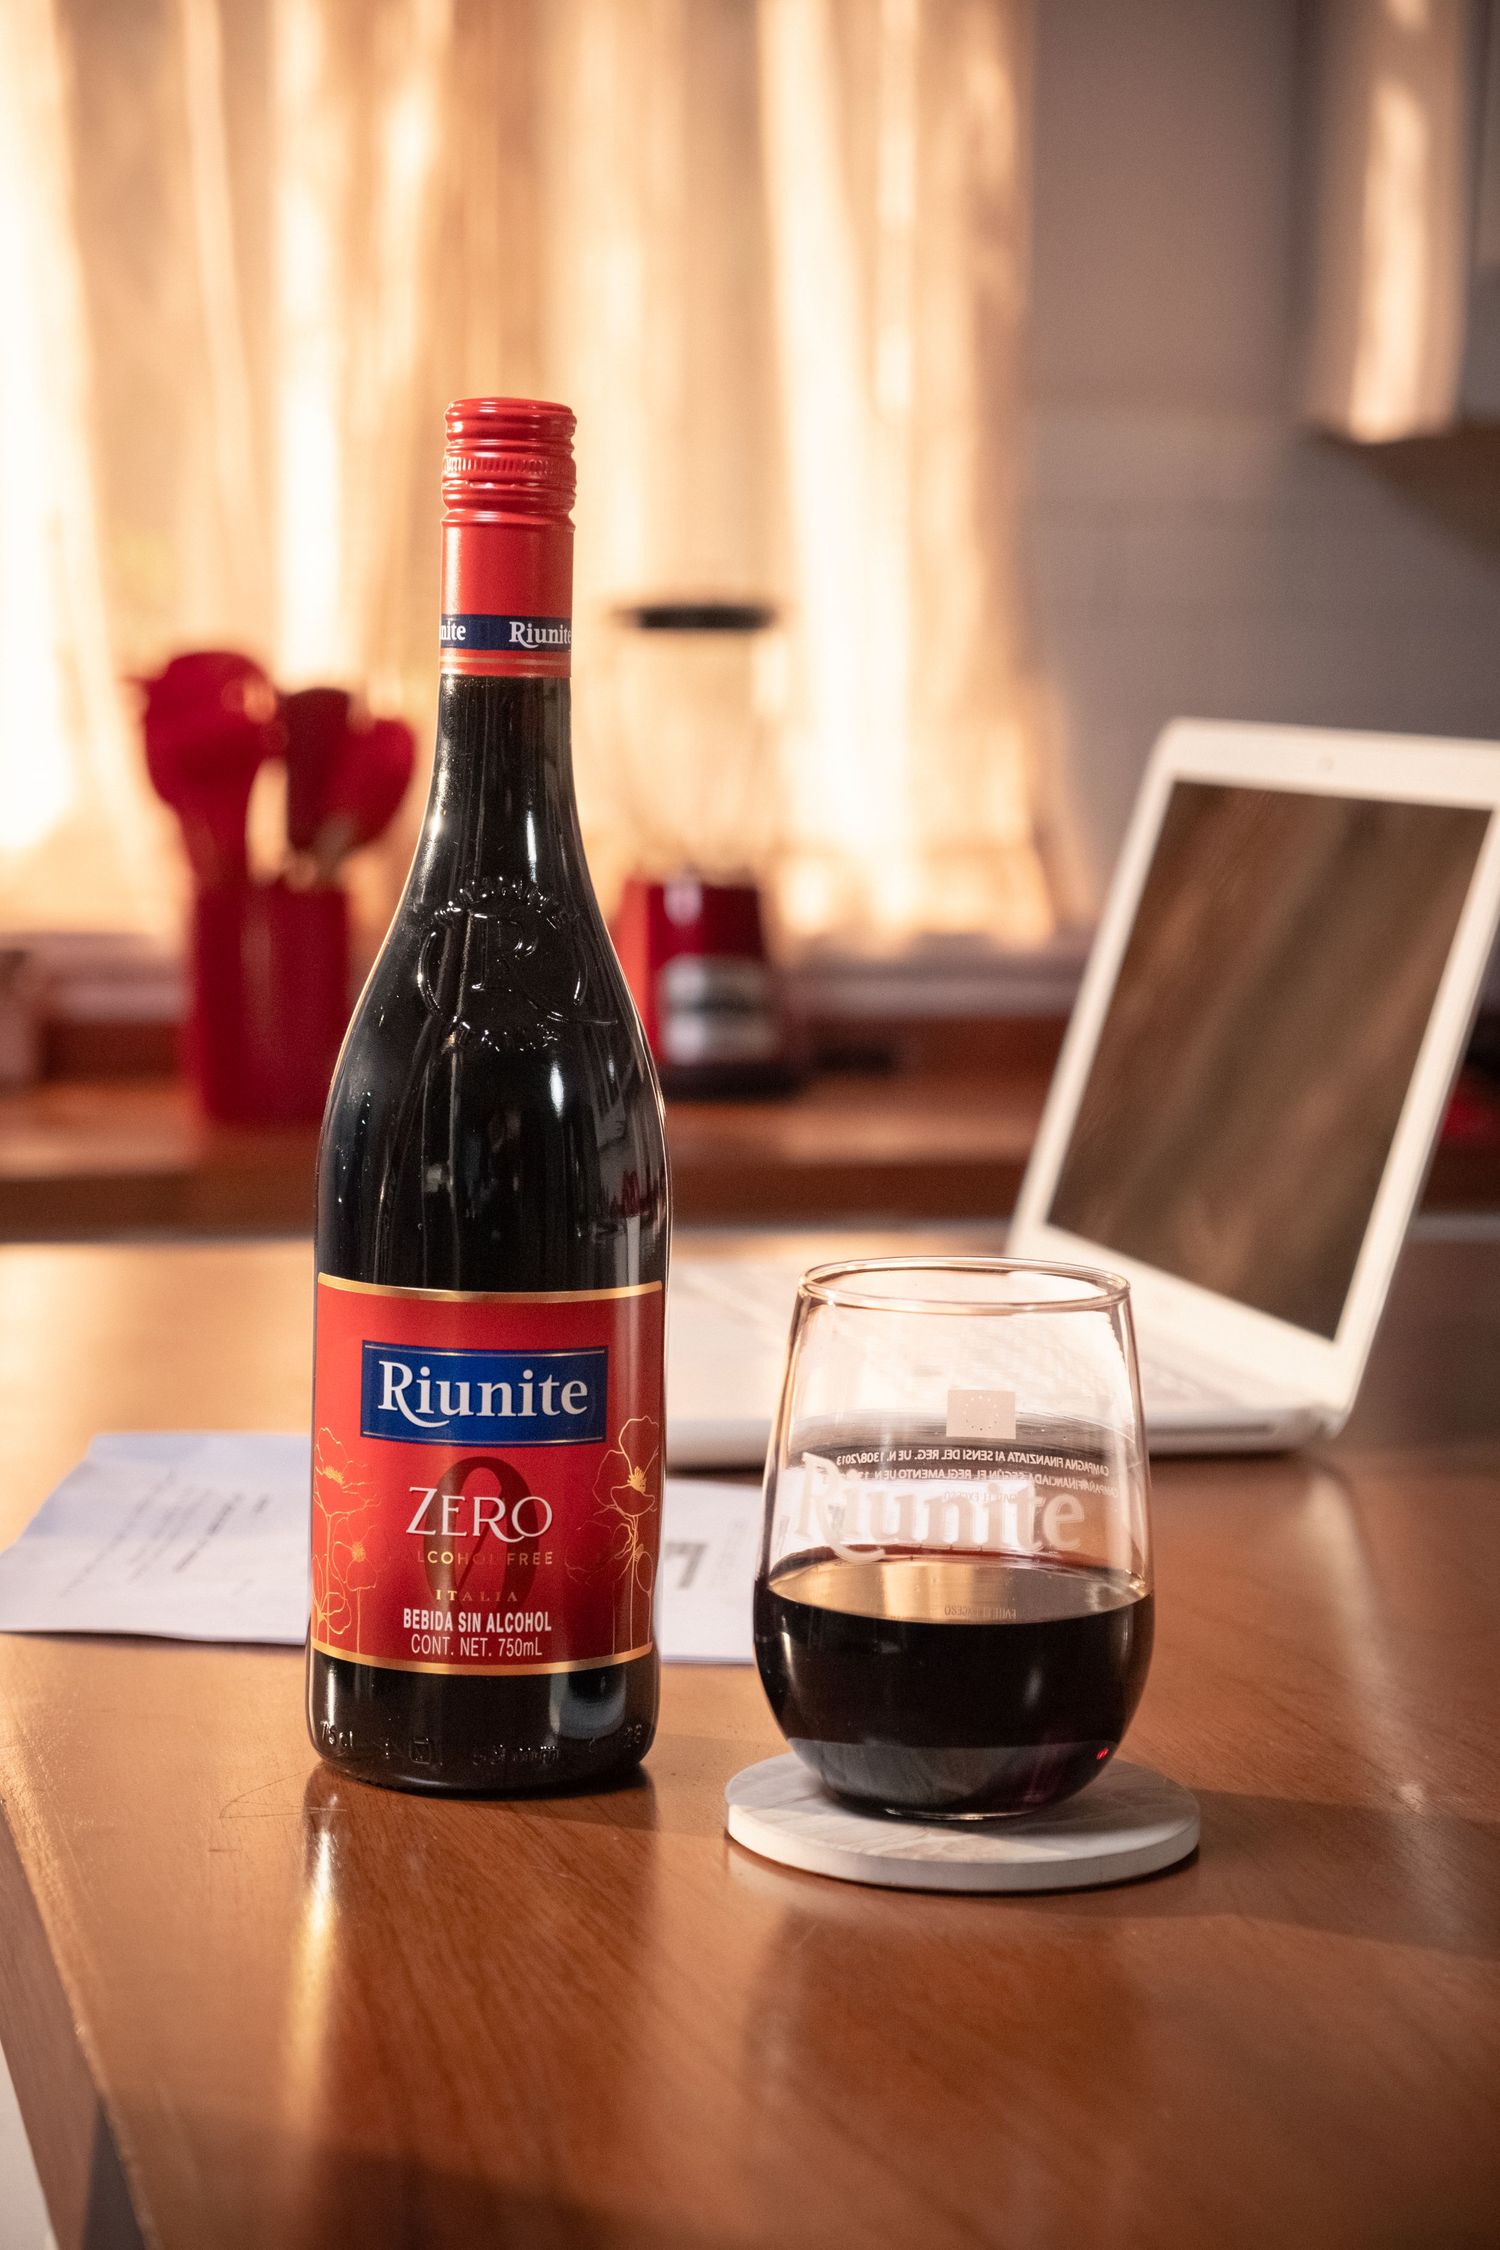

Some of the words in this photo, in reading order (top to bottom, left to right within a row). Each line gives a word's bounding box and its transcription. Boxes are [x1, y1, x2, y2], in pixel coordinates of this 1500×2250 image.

[378, 1360, 588, 1428] Riunite
[406, 1487, 553, 1543] ZERO
[795, 1452, 1085, 1563] Riunite
[507, 1552, 553, 1566] FREE
[436, 1589, 518, 1601] ITALIA
[403, 1608, 453, 1631] BEBIDA
[458, 1612, 481, 1632] SIN
[486, 1612, 552, 1633] ALCOHOL
[411, 1634, 454, 1656] CONT.
[460, 1637, 492, 1657] NET.
[498, 1637, 543, 1657] 750mL
